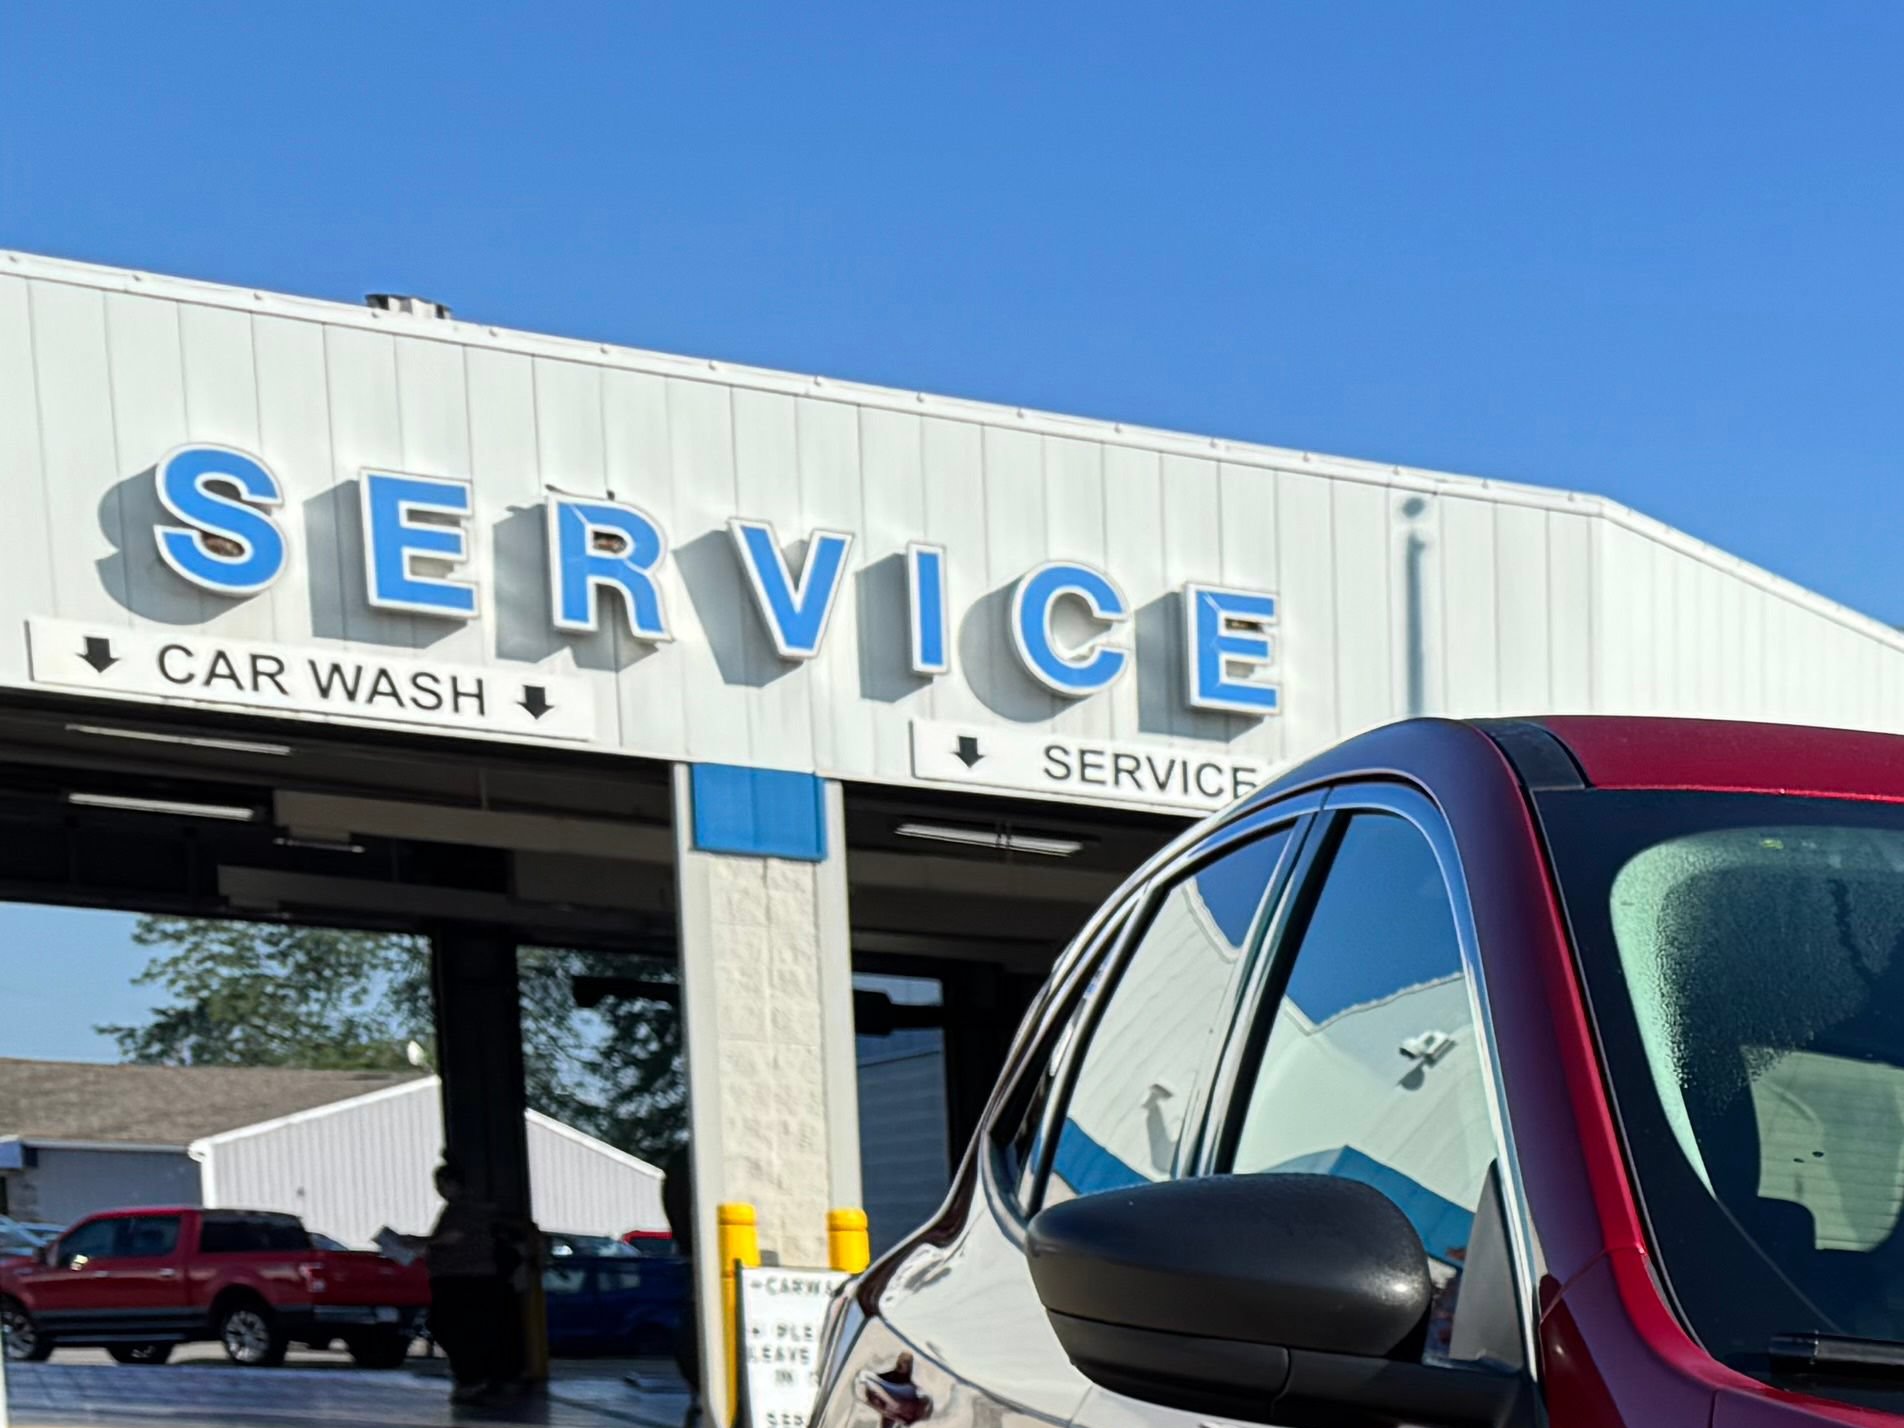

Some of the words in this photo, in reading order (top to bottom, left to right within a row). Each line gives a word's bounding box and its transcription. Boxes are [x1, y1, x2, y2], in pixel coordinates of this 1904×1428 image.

[153, 442, 1281, 715] SERVICE
[157, 644, 288, 696] CAR
[310, 659, 487, 717] WASH
[1043, 744, 1258, 800] SERVICE
